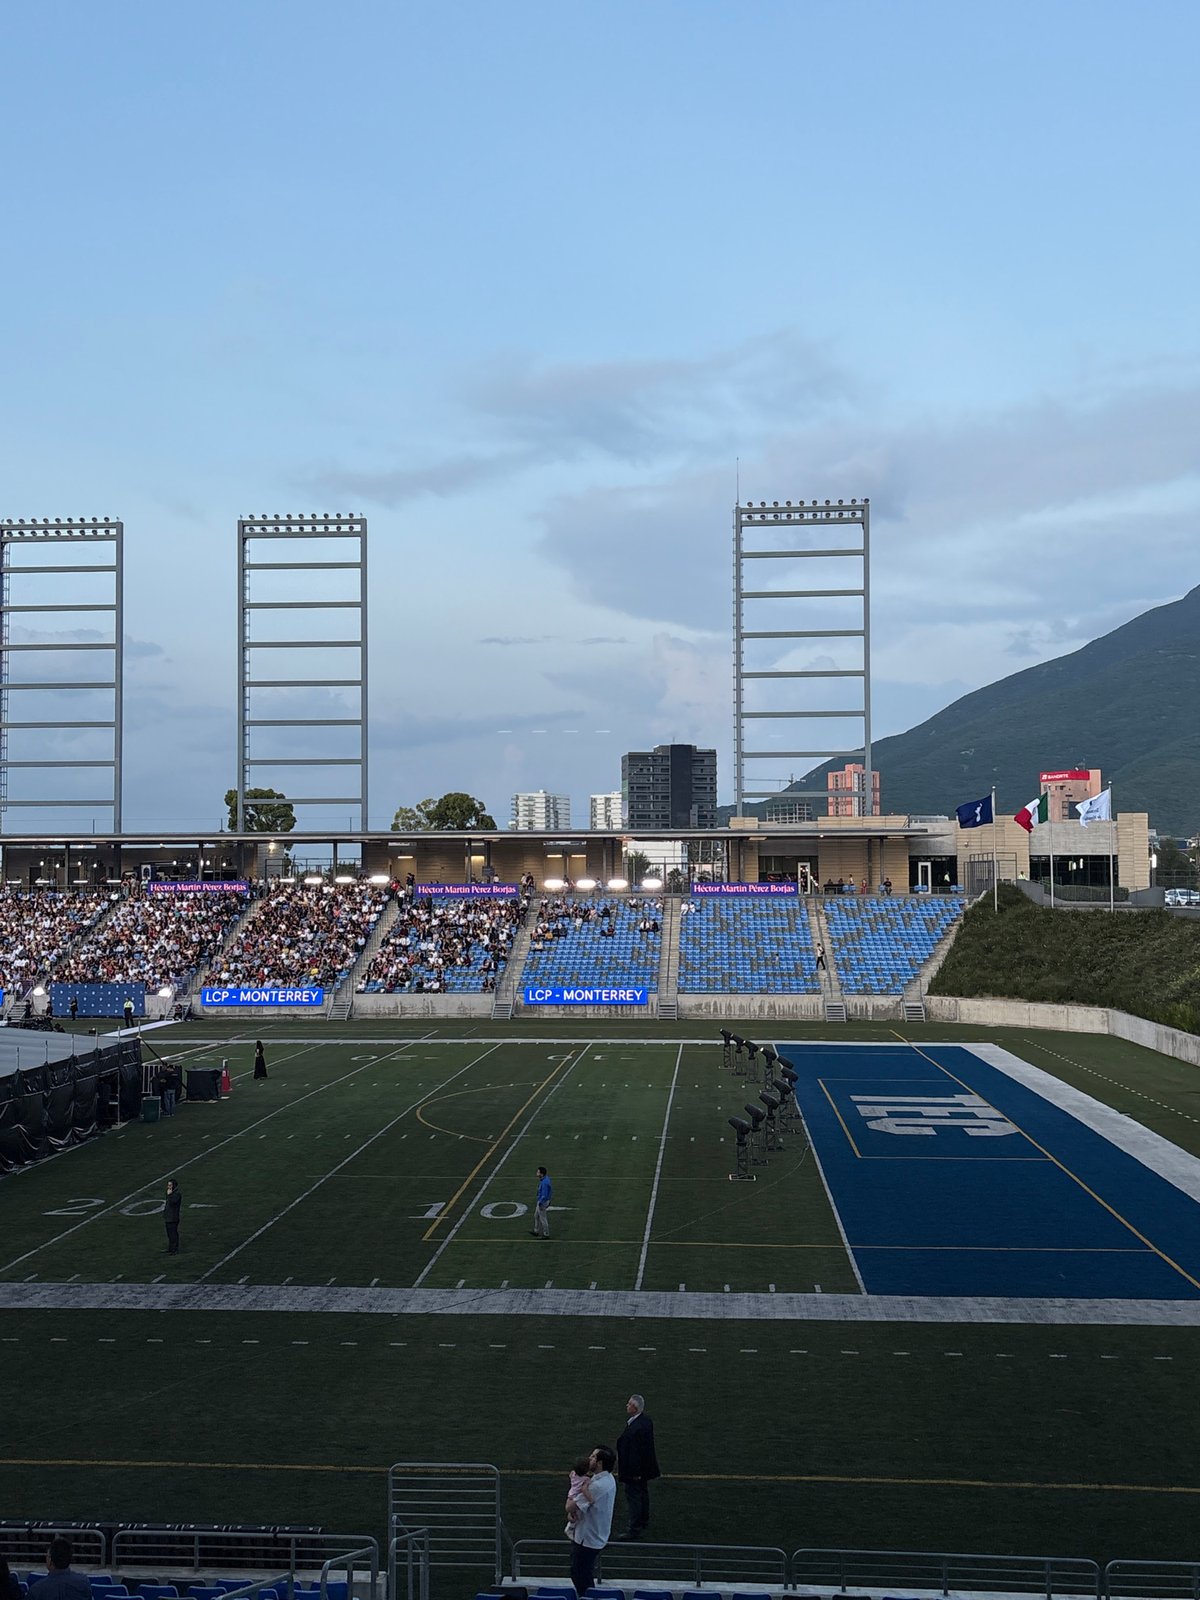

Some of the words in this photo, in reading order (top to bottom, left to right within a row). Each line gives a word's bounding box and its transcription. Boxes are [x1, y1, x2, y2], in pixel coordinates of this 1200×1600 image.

[223, 883, 247, 892] Borjas
[492, 885, 516, 894] Borjas
[770, 884, 795, 893] Borjas
[205, 991, 229, 1002] LCP
[240, 990, 319, 1002] MONTERREY
[529, 990, 553, 1001] LCP
[563, 990, 643, 1001] MONTERREY
[850, 1094, 1020, 1136] TEC
[408, 1201, 529, 1219] 10
